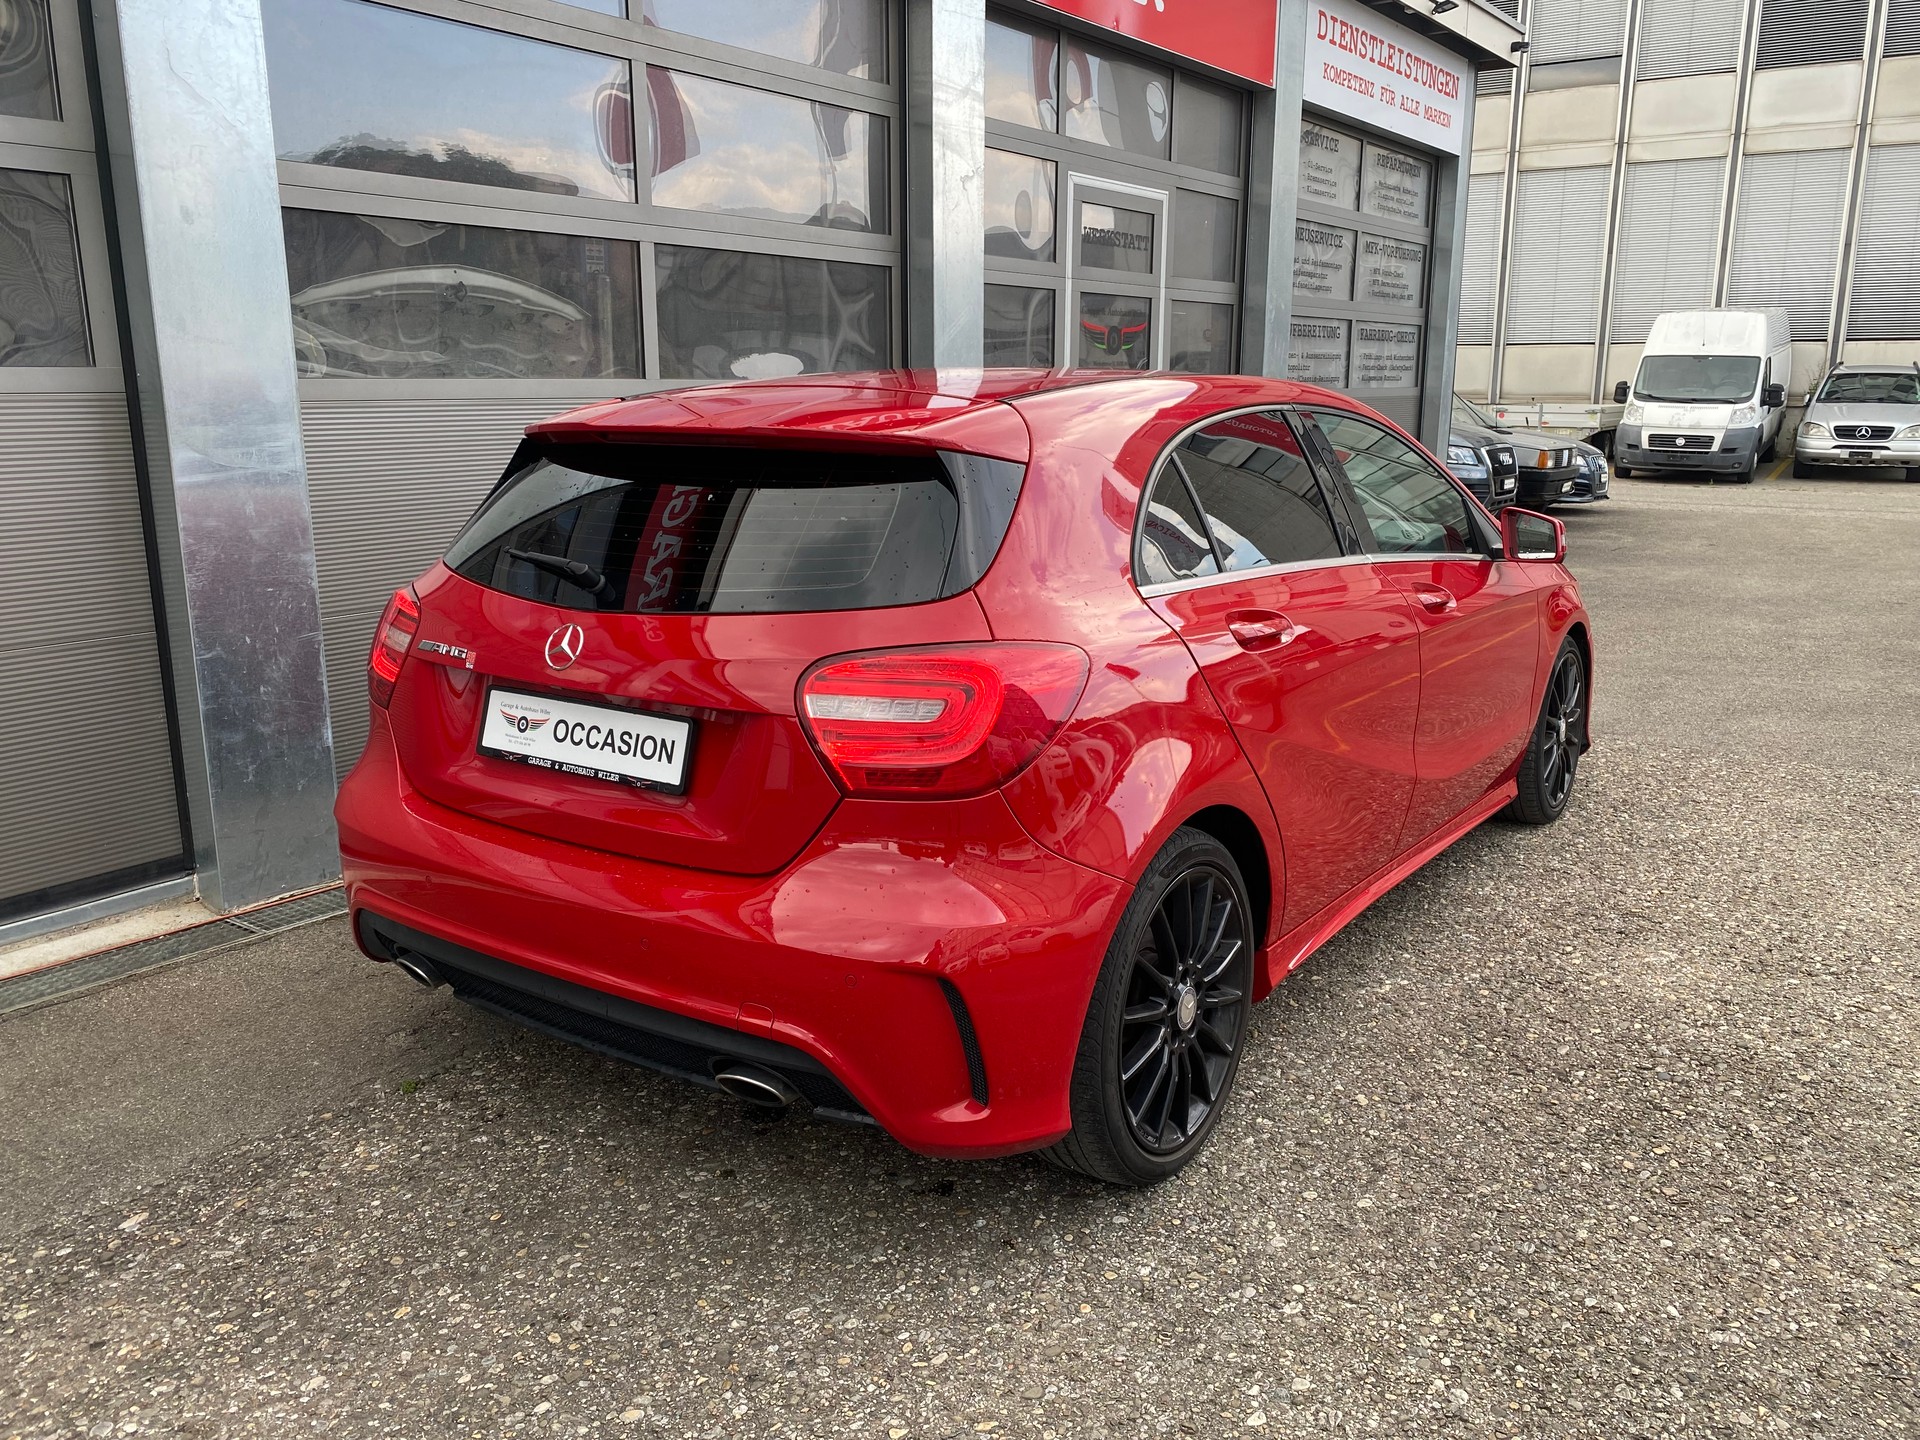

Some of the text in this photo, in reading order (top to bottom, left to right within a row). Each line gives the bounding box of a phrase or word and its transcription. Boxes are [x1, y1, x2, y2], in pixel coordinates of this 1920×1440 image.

[1317, 9, 1460, 100] DIENSTLEISTUNGEN
[1322, 62, 1452, 129] KOMPETENZ FÜR ALLE MARKEN
[1303, 129, 1340, 153] SERVICE
[1376, 153, 1421, 178] REPARATUREN
[1082, 226, 1149, 251] WERKSTATT
[431, 642, 468, 659] AMG
[553, 719, 676, 764] OCCASION
[527, 756, 552, 768] GARAGE
[561, 763, 595, 777] AUTOHAUS
[597, 771, 620, 782] WILER
